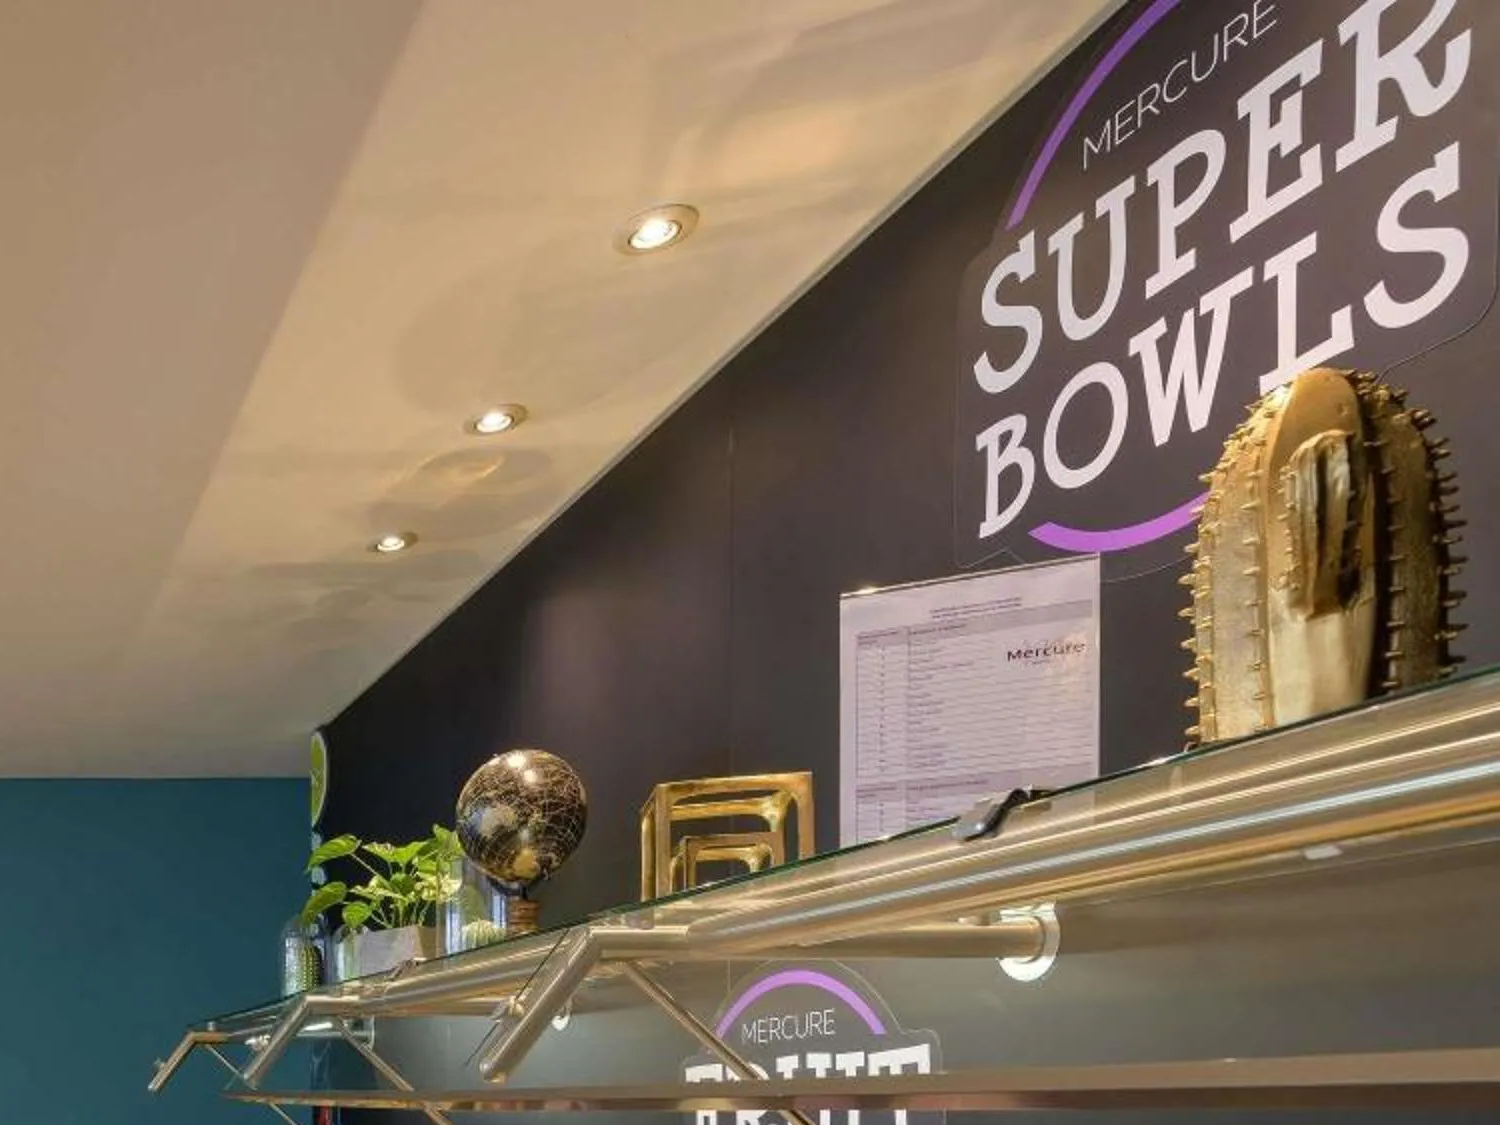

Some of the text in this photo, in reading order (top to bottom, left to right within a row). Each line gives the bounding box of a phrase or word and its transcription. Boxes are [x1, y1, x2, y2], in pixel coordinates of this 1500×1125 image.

[1082, 0, 1277, 170] MERCURE
[973, 0, 1472, 394] SUPER
[975, 141, 1470, 540] BOWLS
[1007, 643, 1085, 662] Mercure
[741, 1008, 836, 1045] MERCURE
